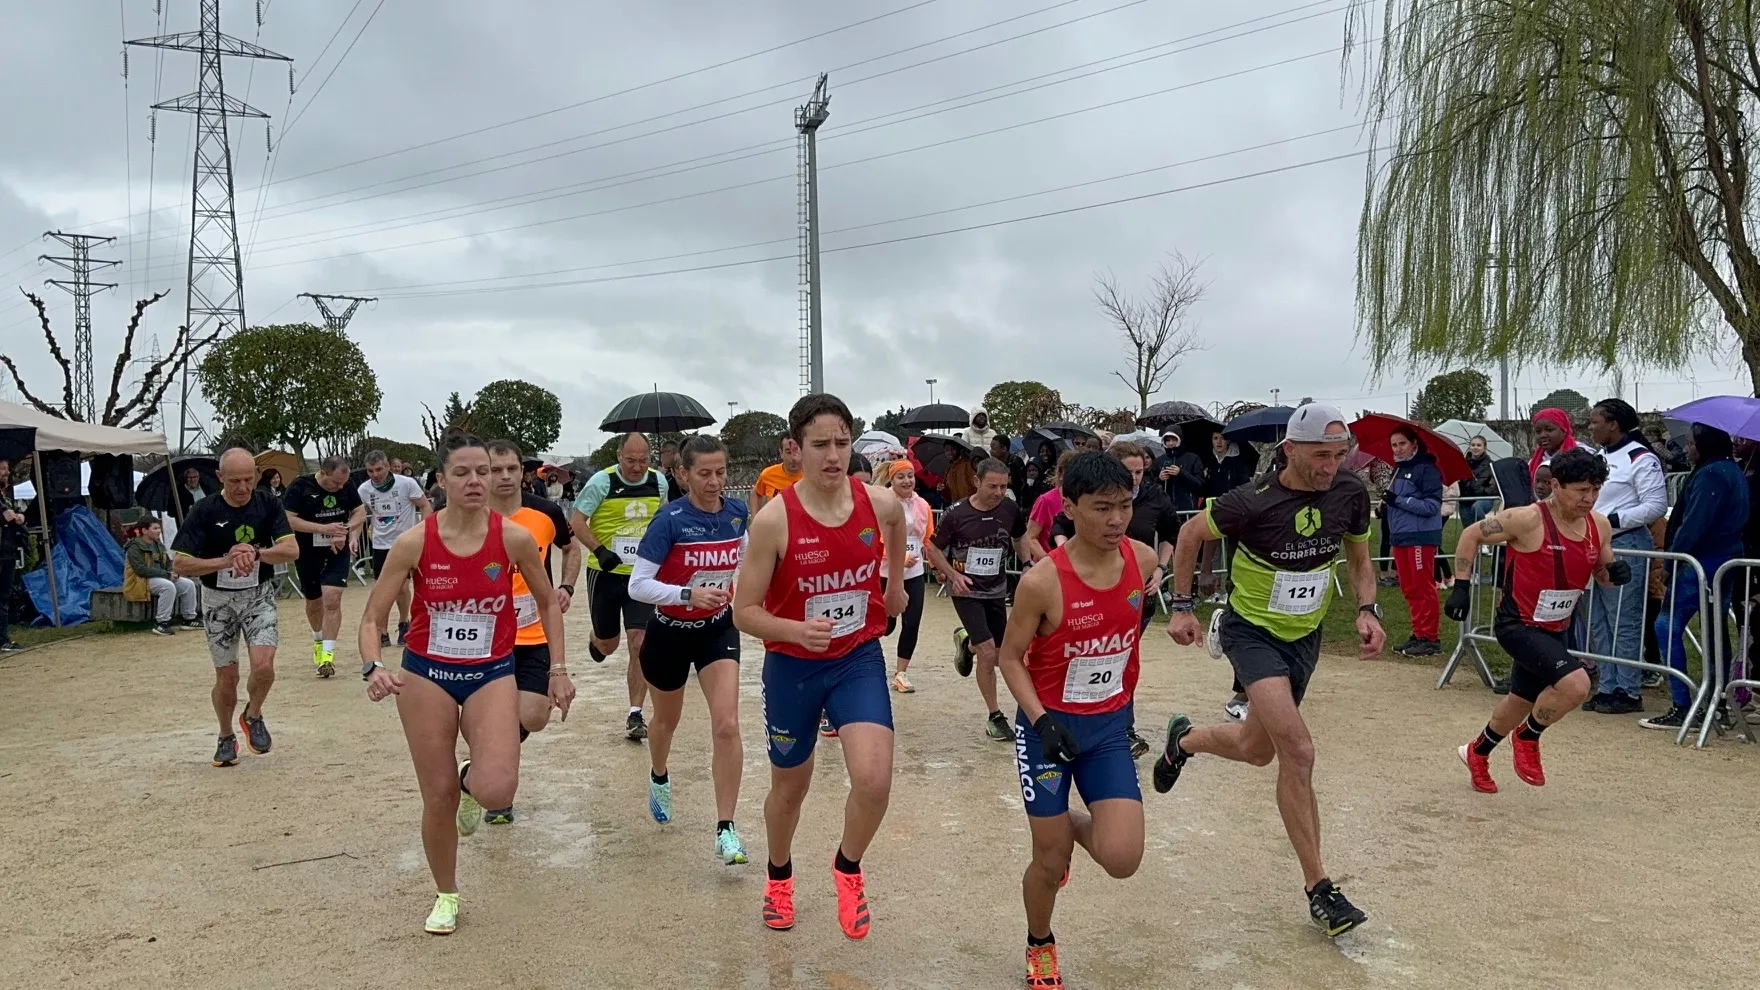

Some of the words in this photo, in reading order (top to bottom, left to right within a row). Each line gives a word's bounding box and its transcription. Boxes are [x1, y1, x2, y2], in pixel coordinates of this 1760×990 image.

[623, 546, 636, 555] 50
[1285, 542, 1294, 551] EL
[1297, 538, 1318, 550] RETO
[1320, 536, 1332, 546] DE
[976, 557, 994, 566] 105
[798, 559, 876, 594] HINACO
[1288, 586, 1316, 599] 121
[423, 595, 507, 615] HINACO
[822, 604, 854, 620] 134
[1550, 600, 1573, 610] 140
[669, 620, 706, 629] PRO
[445, 627, 478, 641] 165
[1063, 623, 1137, 658] HINAC
[428, 667, 484, 681] HINACO
[1088, 670, 1112, 685] 20
[1015, 724, 1036, 802] HINACO
